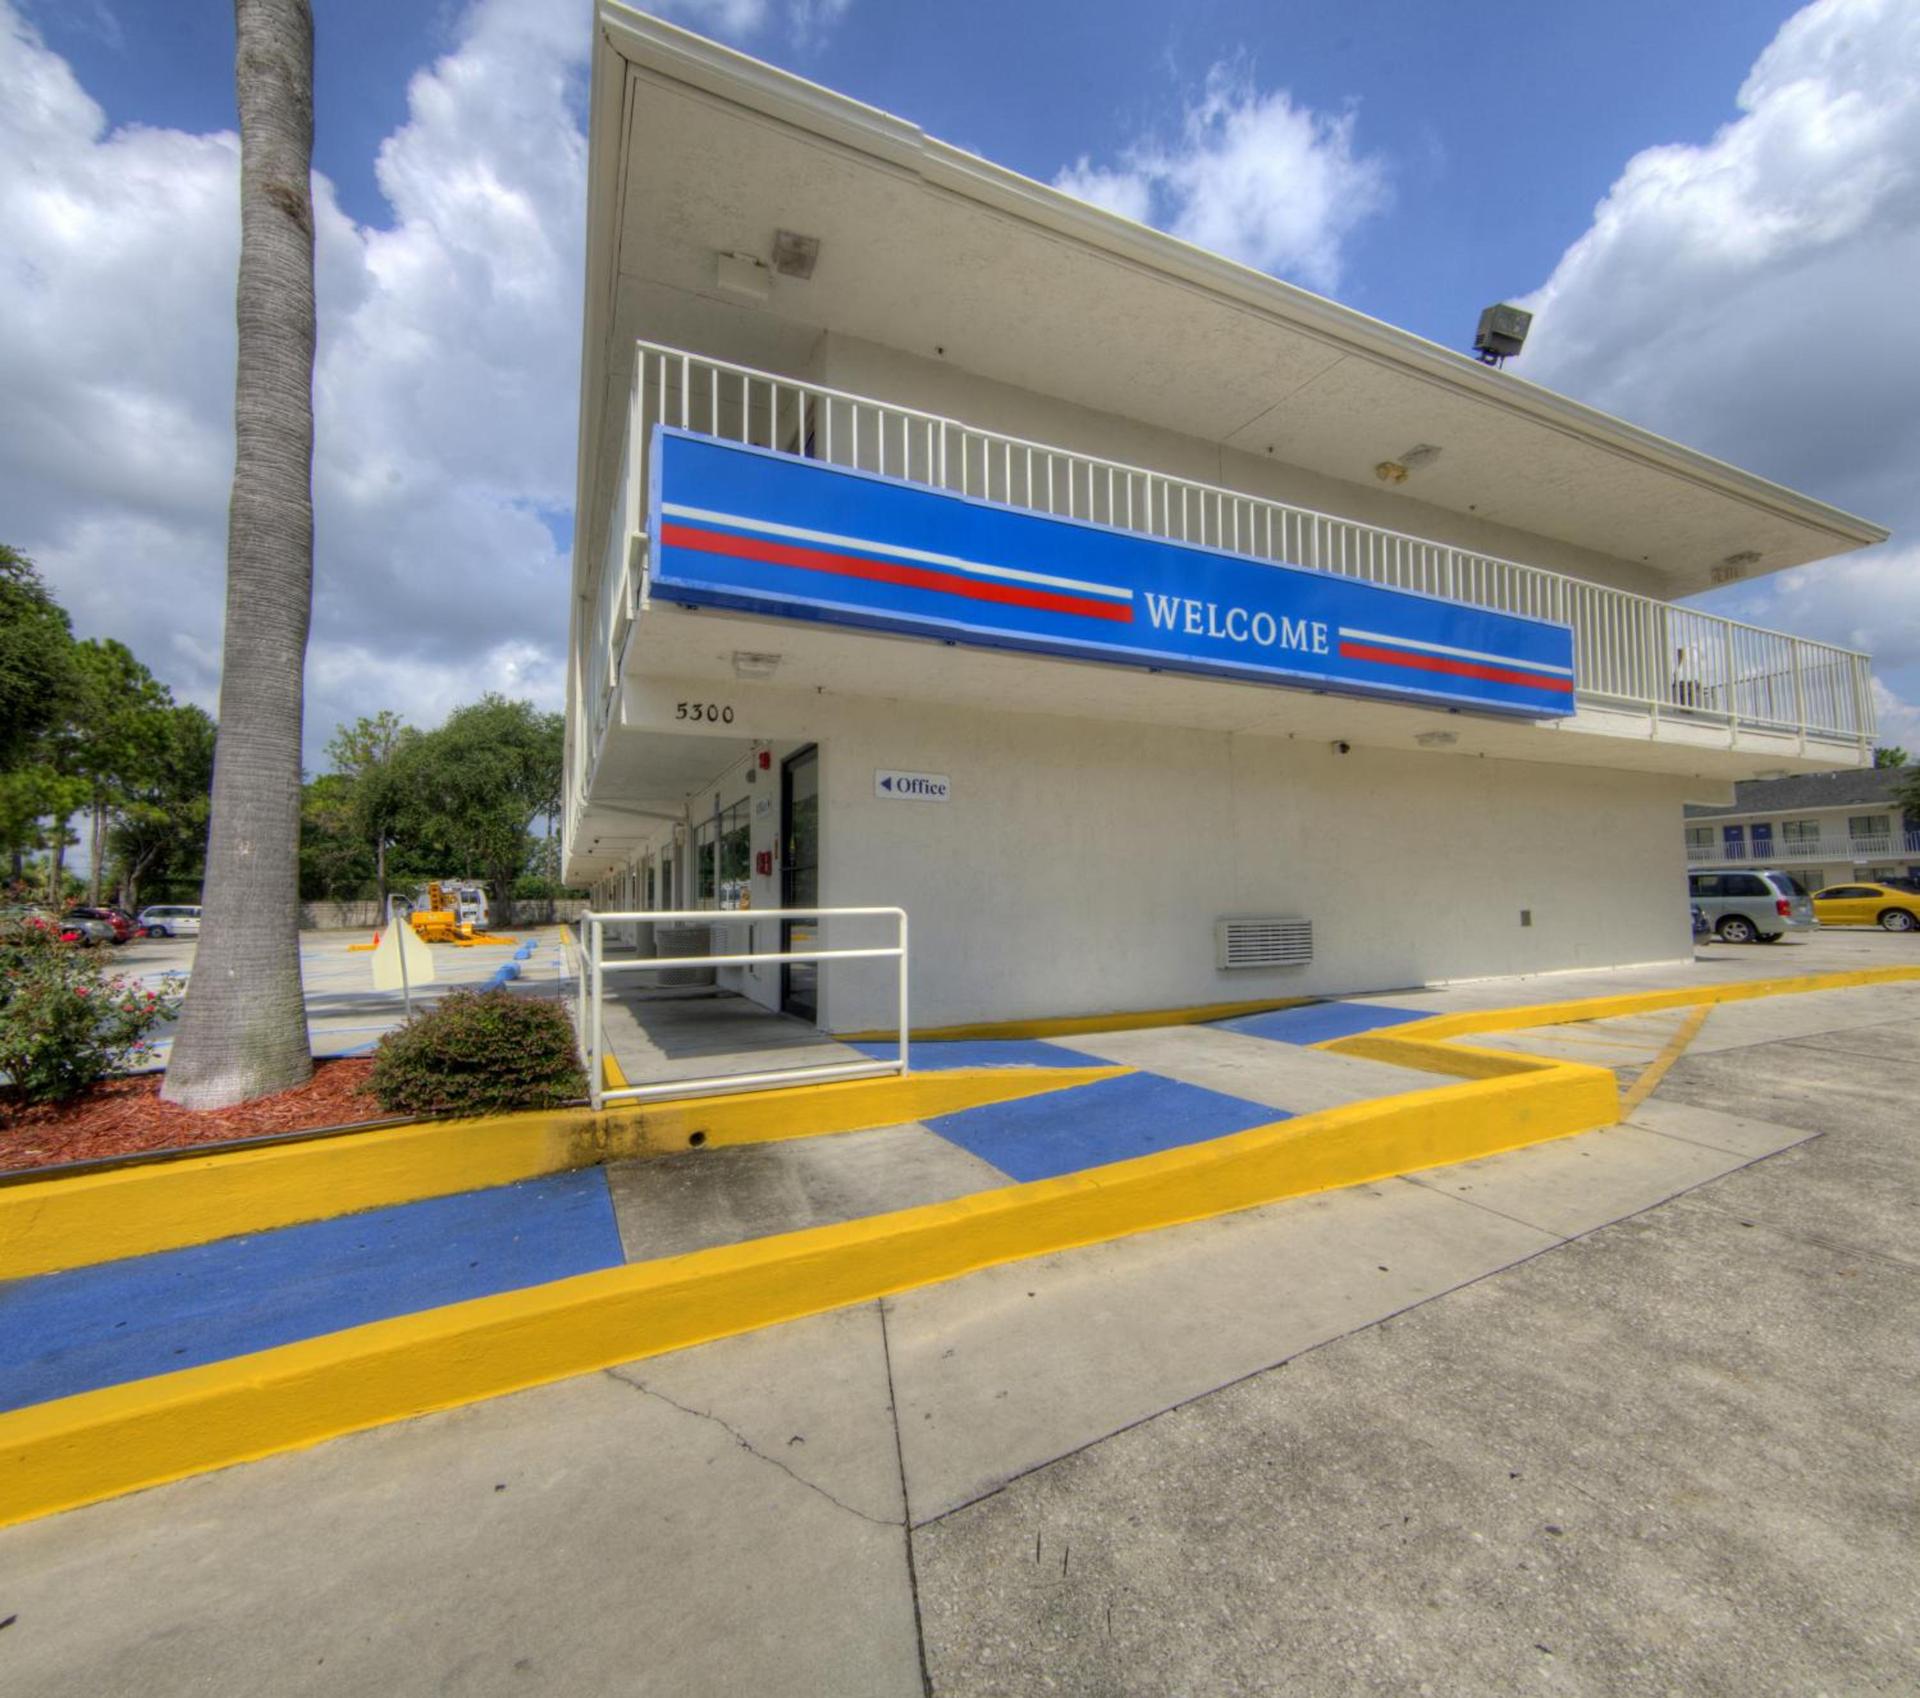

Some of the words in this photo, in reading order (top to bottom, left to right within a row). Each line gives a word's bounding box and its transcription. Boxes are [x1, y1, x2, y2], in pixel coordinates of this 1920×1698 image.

[1144, 592, 1329, 655] WELCOME
[675, 702, 734, 724] 5300
[896, 777, 946, 795] Office
